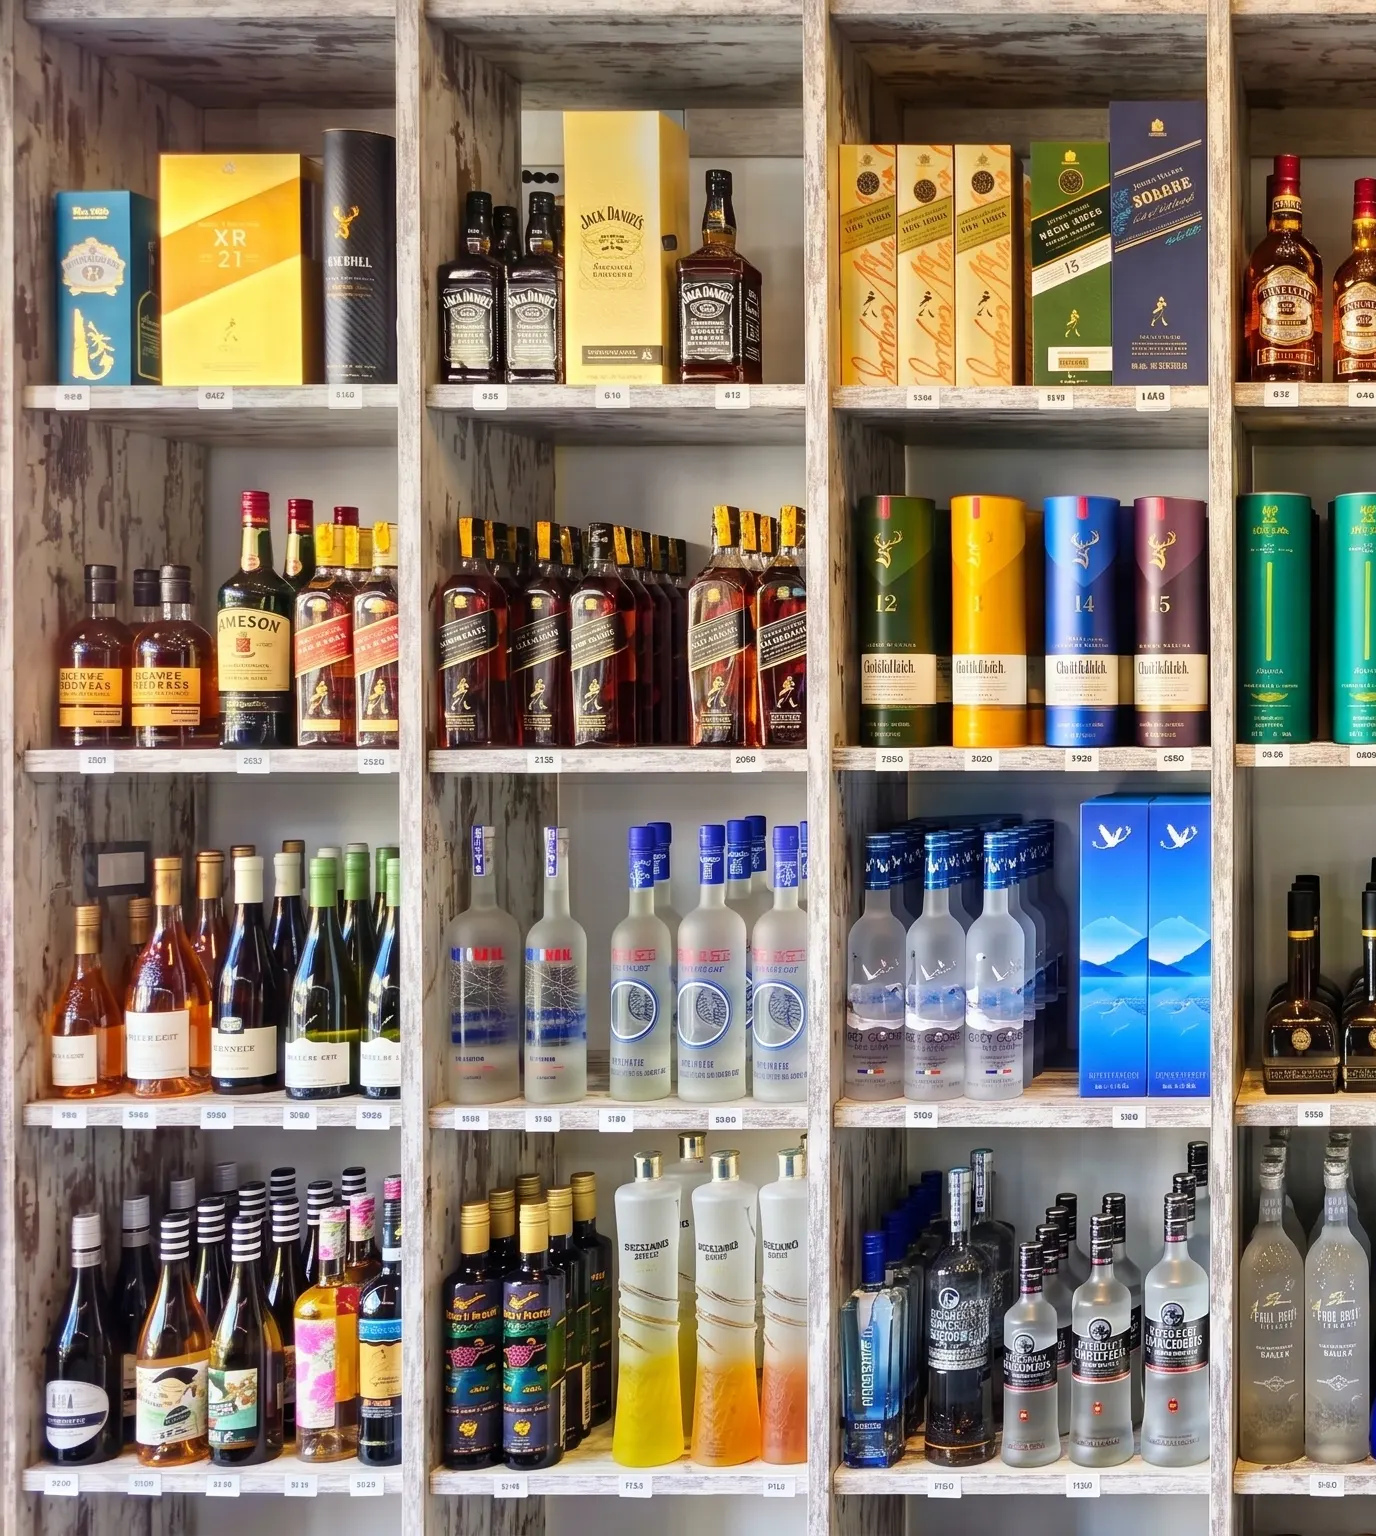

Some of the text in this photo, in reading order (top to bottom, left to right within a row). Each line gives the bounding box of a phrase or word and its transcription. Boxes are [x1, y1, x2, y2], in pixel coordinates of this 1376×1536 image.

[214, 229, 246, 247] XR
[218, 250, 241, 268] 21
[876, 594, 898, 612] 12
[1074, 595, 1095, 613] 14
[1150, 595, 1171, 613] 15
